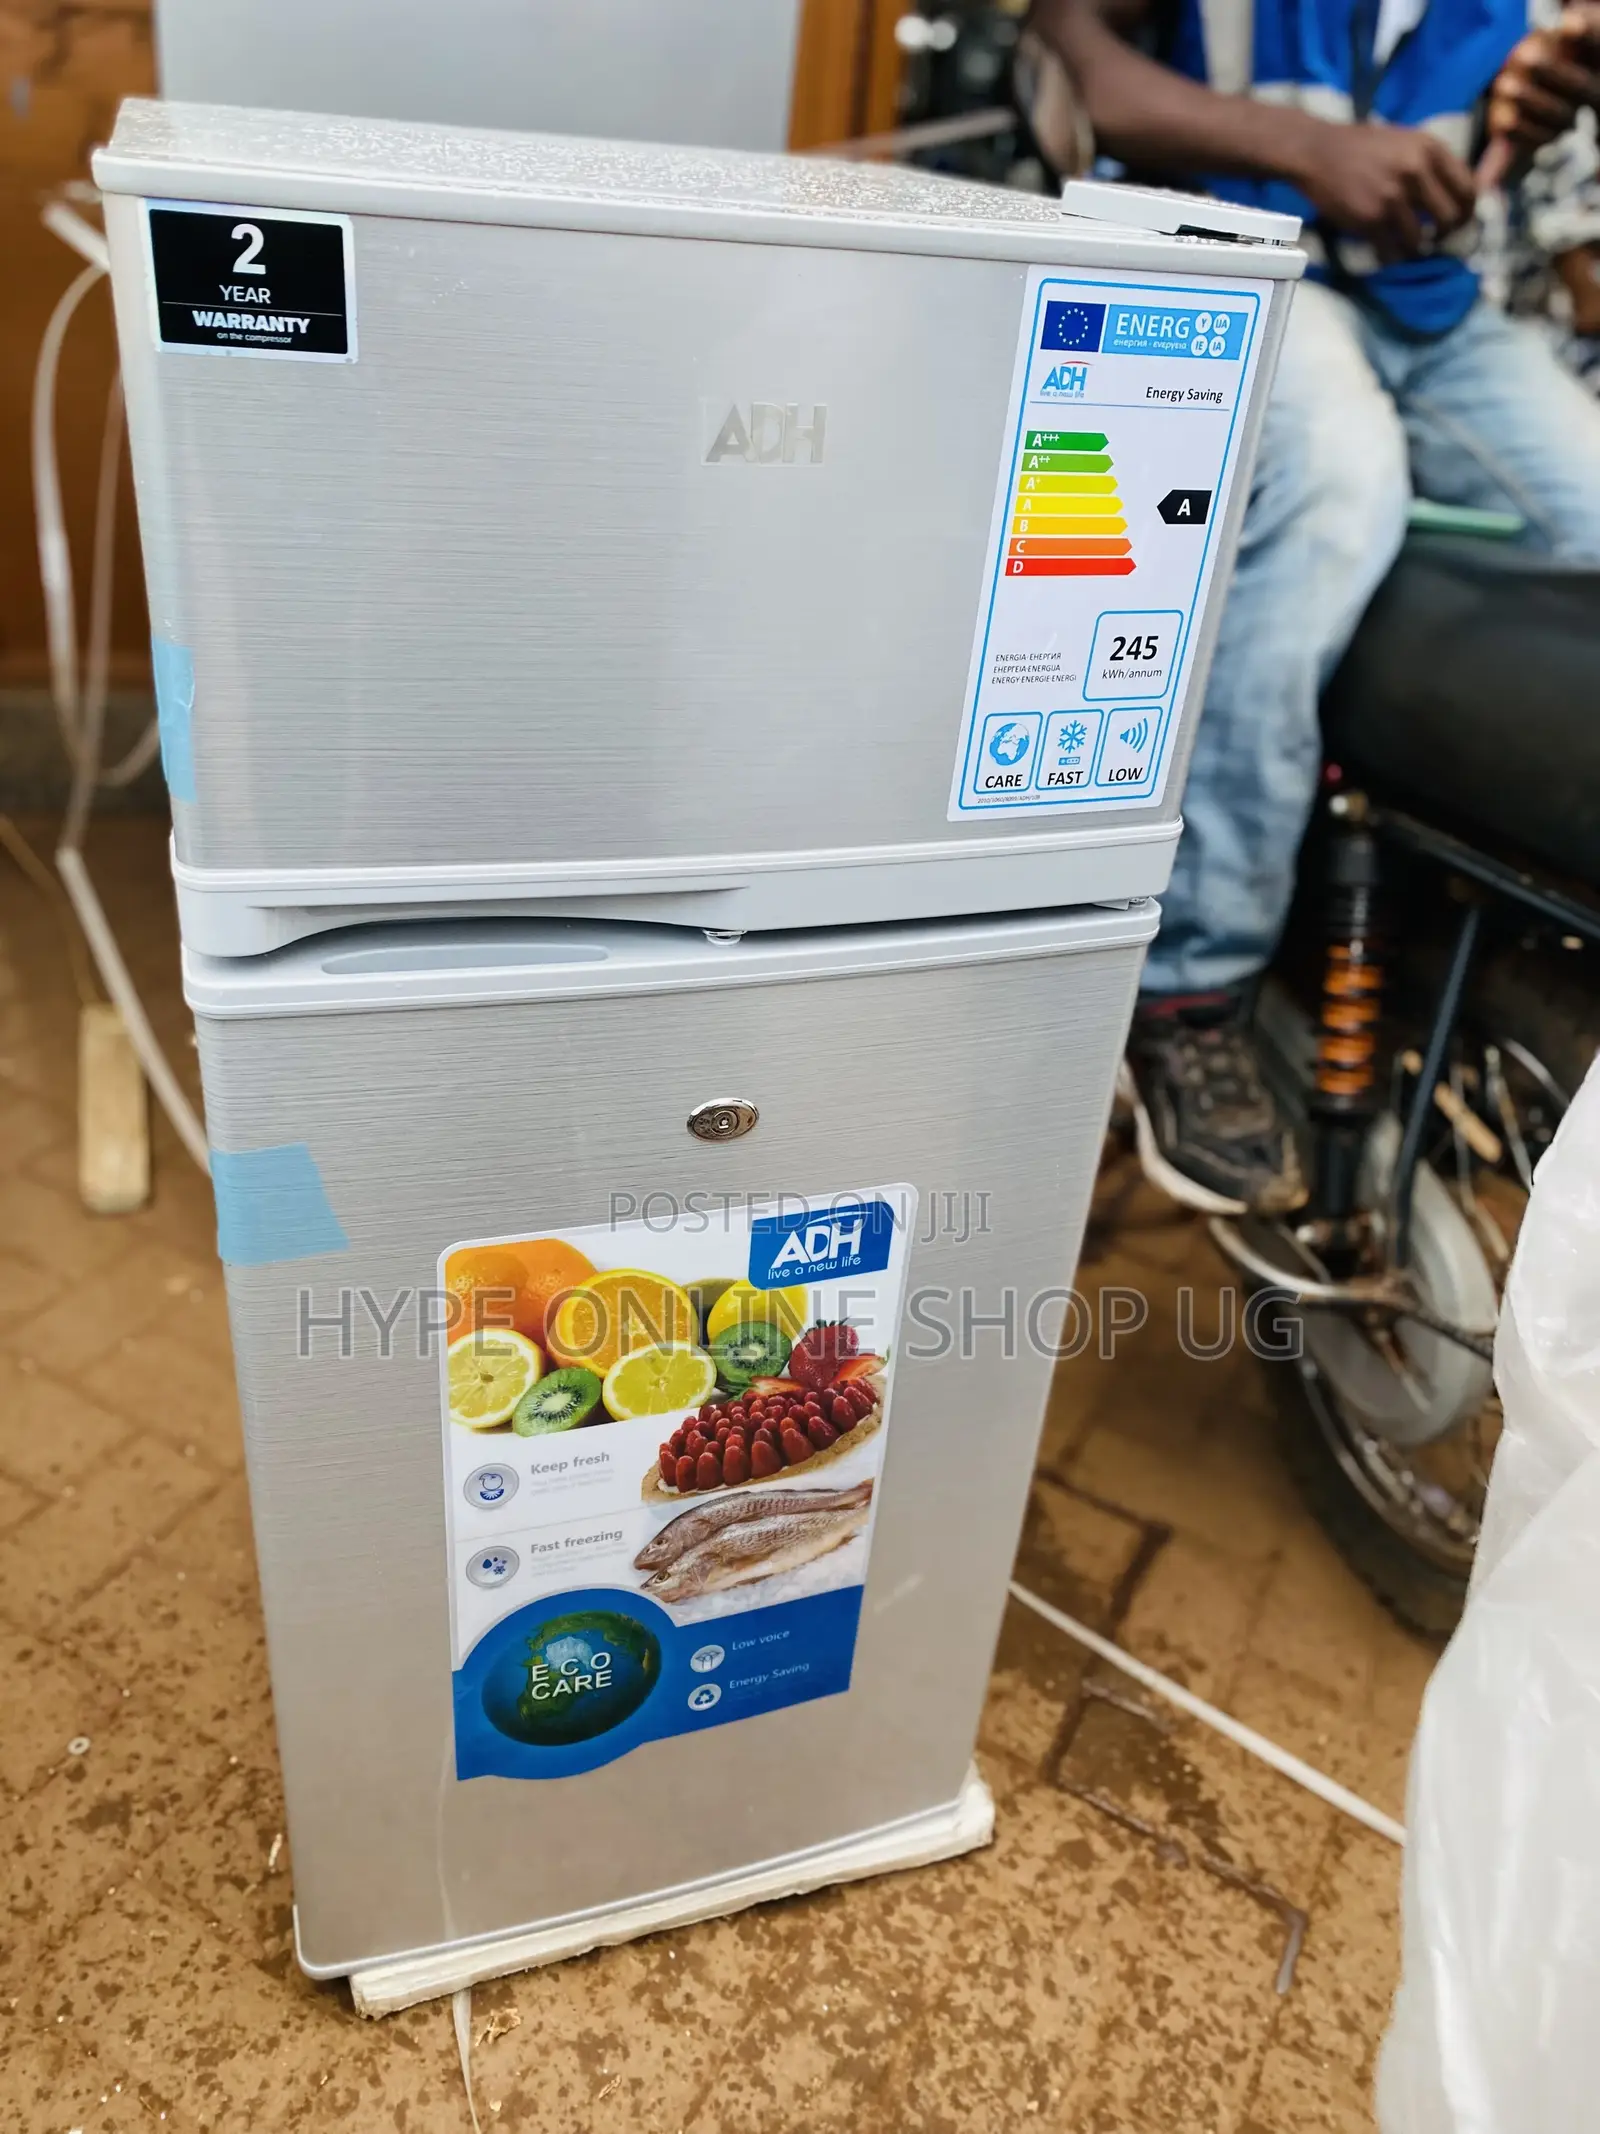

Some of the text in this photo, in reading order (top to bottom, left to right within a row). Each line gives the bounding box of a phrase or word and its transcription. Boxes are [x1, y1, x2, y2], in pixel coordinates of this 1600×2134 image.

[231, 223, 266, 275] 2
[219, 284, 271, 304] YEAR
[192, 310, 311, 334] WARRANTY
[1116, 313, 1190, 339] ENERG
[217, 332, 292, 343] on the compressor
[1040, 366, 1087, 390] ADH
[1146, 386, 1223, 403] Energy Saving
[705, 401, 828, 464] ADH
[1022, 497, 1032, 511] A
[1176, 498, 1191, 516] A
[1019, 519, 1029, 532] B
[1016, 540, 1026, 553] C
[1012, 561, 1024, 574] D
[995, 653, 1027, 662] ENERGIA
[1109, 635, 1159, 662] 245
[991, 676, 1020, 684] ENERGY
[1101, 668, 1162, 680] kWh/annum
[985, 774, 1023, 789] CARE
[1047, 771, 1084, 786] FAST
[1108, 767, 1143, 782] LOW
[770, 1218, 863, 1269] ADH
[767, 1255, 862, 1280] live a new life
[530, 1452, 610, 1475] Keep fresh
[530, 1529, 623, 1554] Fast freezing
[731, 1629, 790, 1651] Low voice
[531, 1651, 612, 1682] ECO
[729, 1661, 810, 1690] Energy Saving
[531, 1669, 613, 1700] CARE
